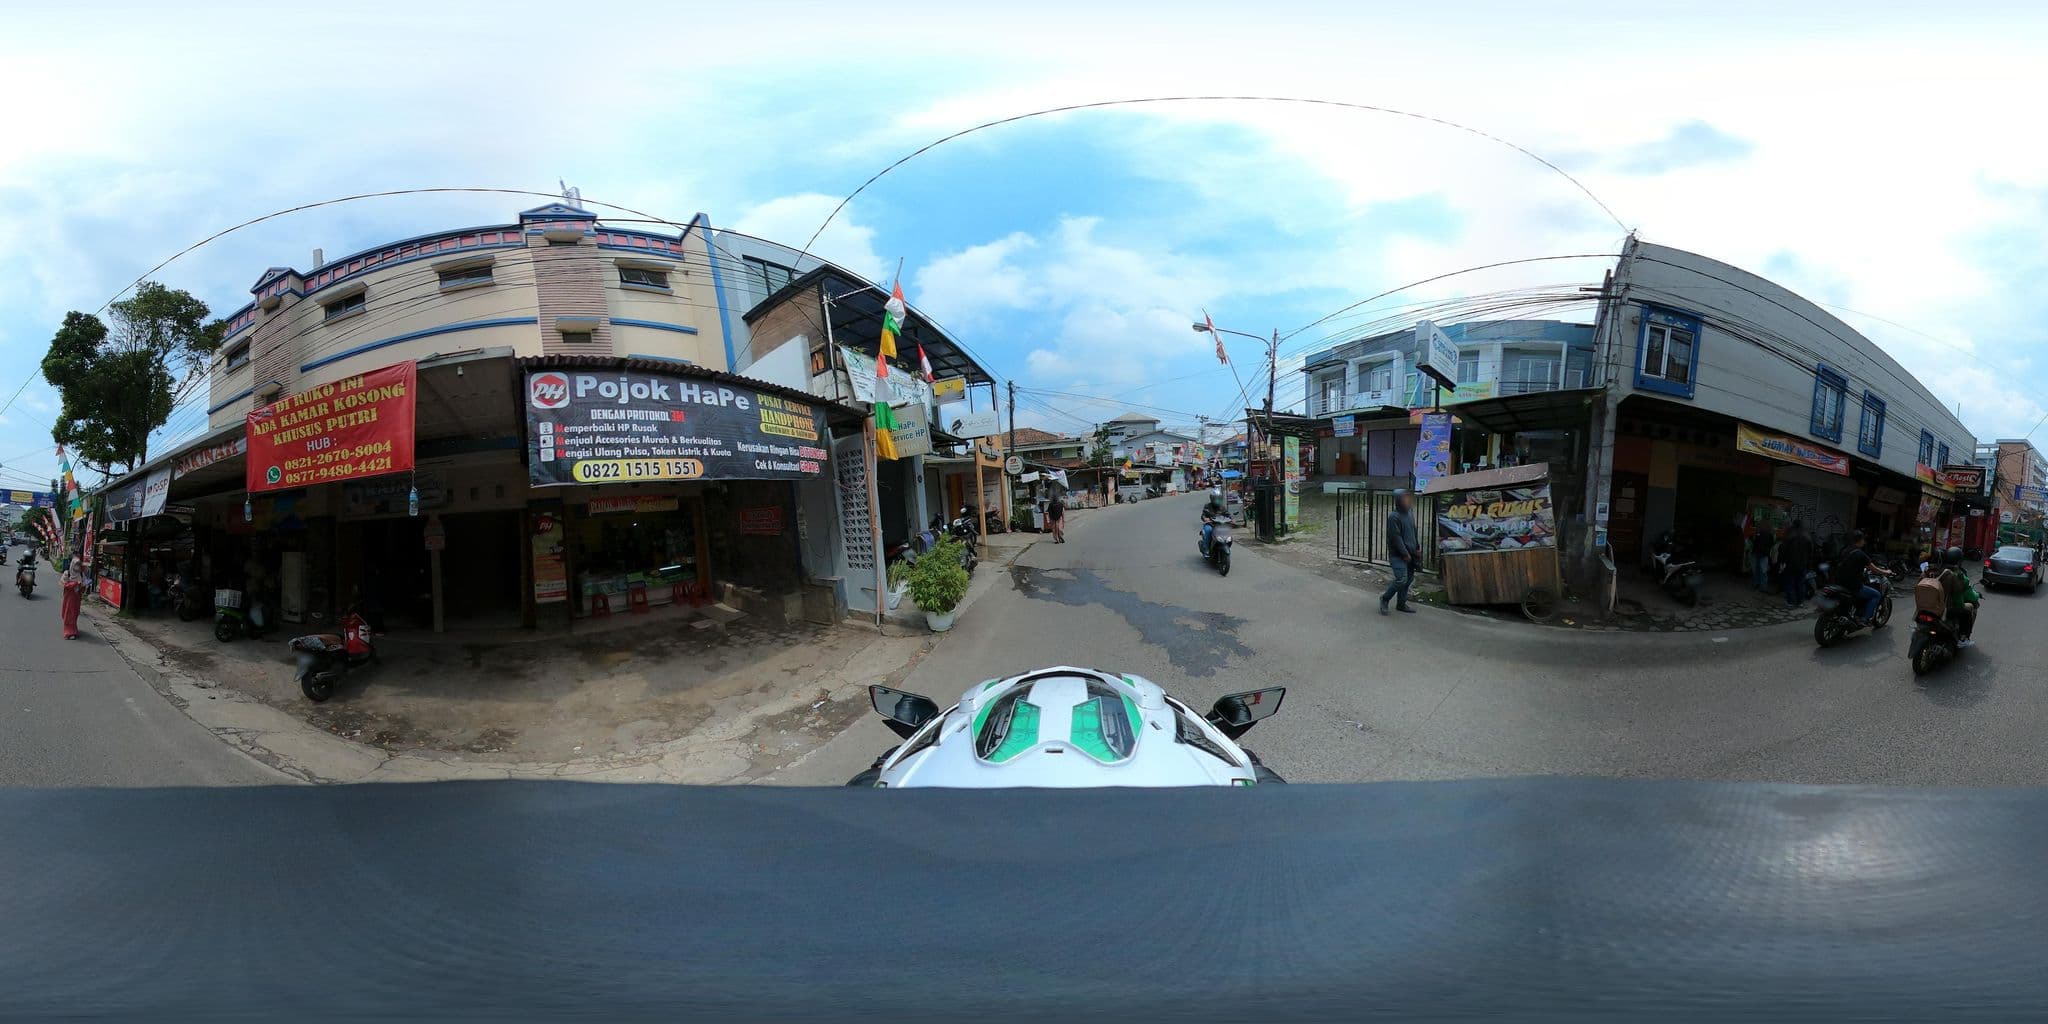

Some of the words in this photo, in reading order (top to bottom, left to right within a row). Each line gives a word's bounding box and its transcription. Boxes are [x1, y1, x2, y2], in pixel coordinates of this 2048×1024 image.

[275, 401, 290, 414] DI
[292, 384, 335, 408] RUKO
[339, 375, 365, 393] INI
[534, 383, 565, 399] PH
[575, 375, 671, 404] Pojok
[680, 382, 750, 410] HaPe
[253, 419, 277, 436] ADA
[279, 402, 329, 427] KAMAR
[333, 383, 406, 412] KOSONG
[757, 394, 782, 409] PUSAT
[783, 400, 813, 416] SERVICE
[591, 409, 627, 420] DENGAN
[627, 410, 671, 422] PROTOKOL
[760, 408, 816, 431] HANDPHONE
[273, 422, 323, 446] KHUSUS
[326, 407, 378, 432] PUTRI
[555, 423, 616, 434] Memperbaiki
[618, 424, 630, 432] HP
[632, 424, 658, 433] Rusak
[915, 428, 925, 438] HP
[306, 437, 331, 452] HUB
[556, 435, 593, 447] Menjual
[595, 435, 641, 445] Accesories
[642, 435, 669, 444] Murah
[671, 435, 678, 444] &
[680, 436, 722, 446] Berkualitas
[737, 441, 769, 454] Kerusakan
[284, 440, 392, 471] 0821-2670-8004
[556, 448, 593, 459] Mengisi
[595, 448, 622, 458] Ulang
[653, 447, 676, 456] Token
[678, 448, 701, 456] Listrik
[703, 448, 709, 456] &
[710, 448, 732, 457] Kuota
[285, 456, 392, 484] 0877-9480-4421
[583, 463, 620, 478] 0822
[625, 462, 661, 477] 1515
[666, 461, 697, 476] 1551
[755, 460, 767, 470] Cek
